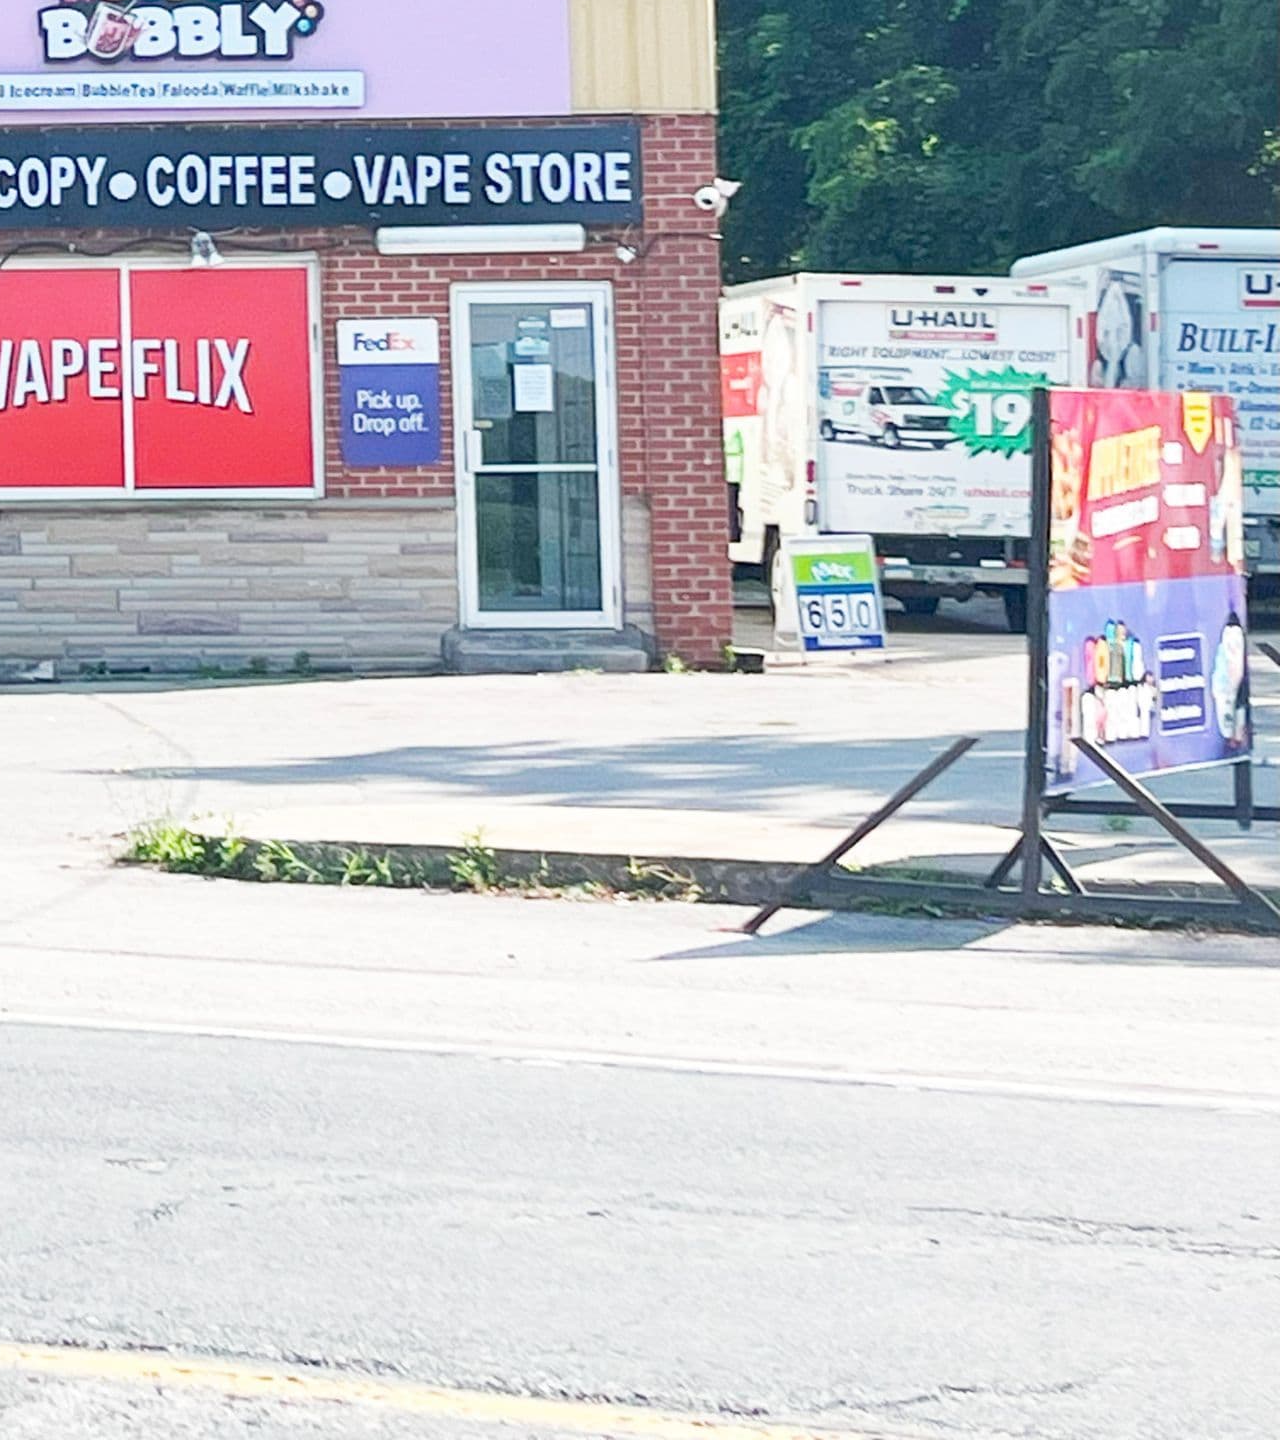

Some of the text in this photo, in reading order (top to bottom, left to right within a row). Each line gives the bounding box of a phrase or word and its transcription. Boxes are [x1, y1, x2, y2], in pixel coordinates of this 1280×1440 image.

[145, 154, 316, 207] COFFEE
[354, 153, 471, 205] VAPE
[485, 152, 632, 203] STORE
[891, 310, 994, 328] U-HAUL
[353, 333, 416, 351] FedEx
[1177, 323, 1280, 353] BUILT-I
[356, 390, 393, 409] Pick
[353, 413, 396, 437] Drop
